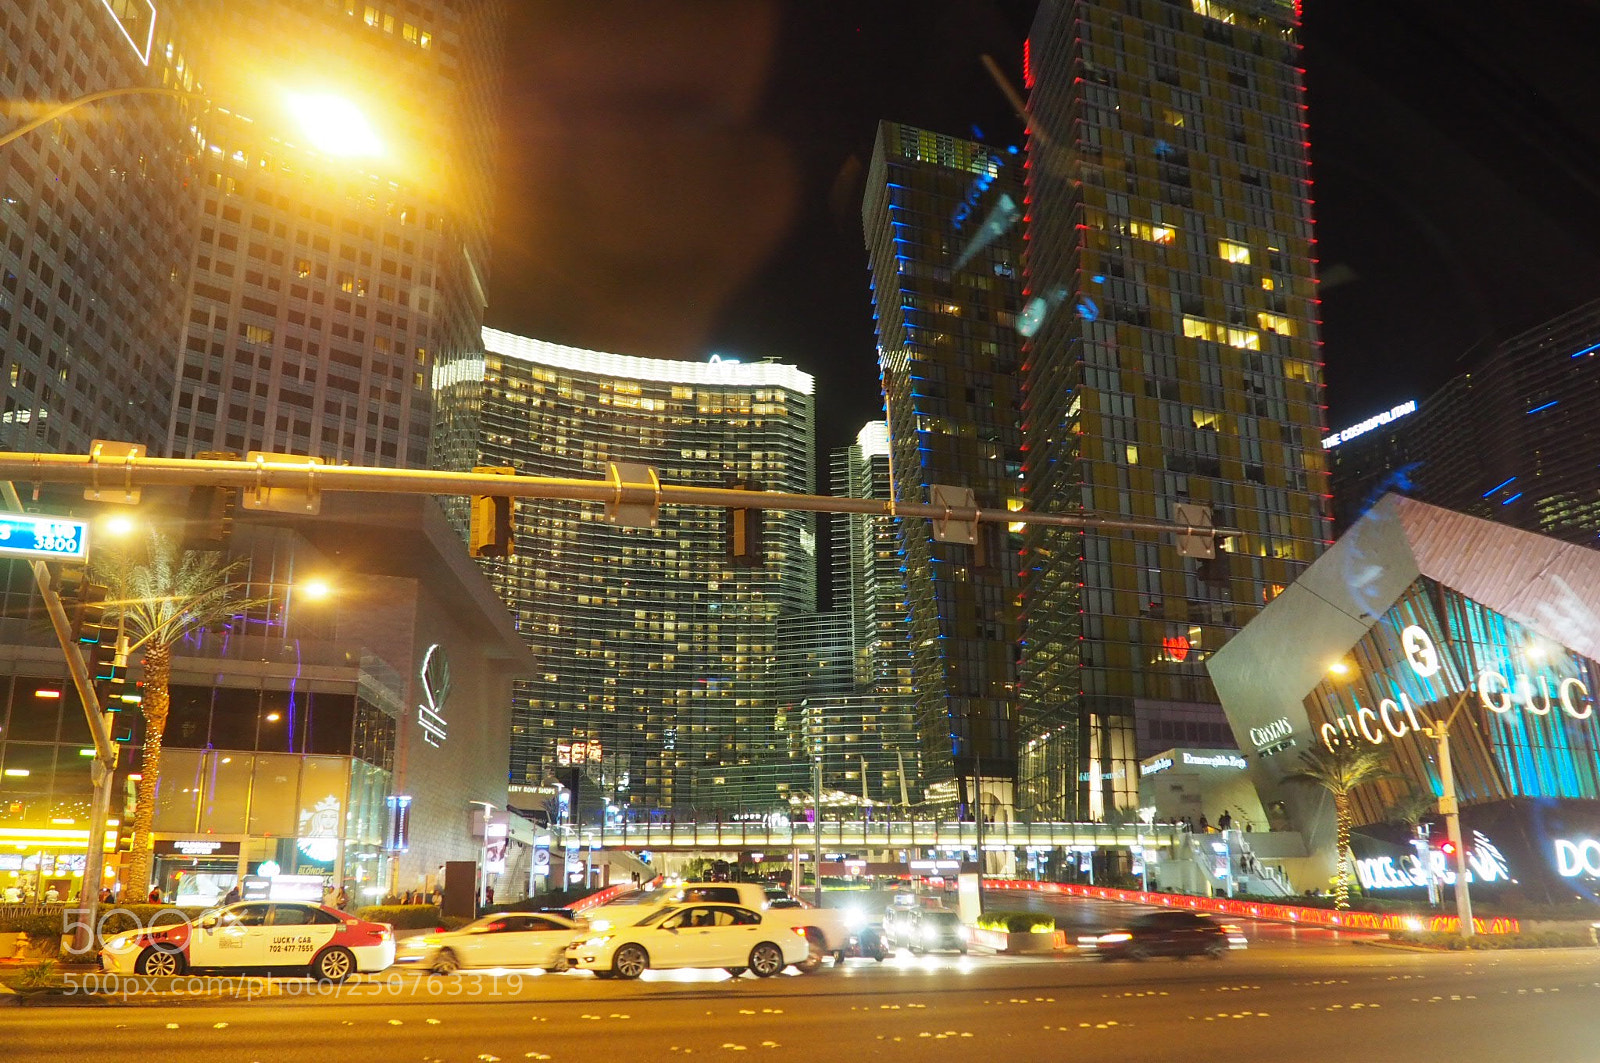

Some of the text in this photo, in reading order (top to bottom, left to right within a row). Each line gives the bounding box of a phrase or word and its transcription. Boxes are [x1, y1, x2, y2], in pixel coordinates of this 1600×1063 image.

[1321, 400, 1417, 449] THE COSMOPOLITAN
[33, 535, 77, 552] 3800
[297, 936, 311, 944] CAB
